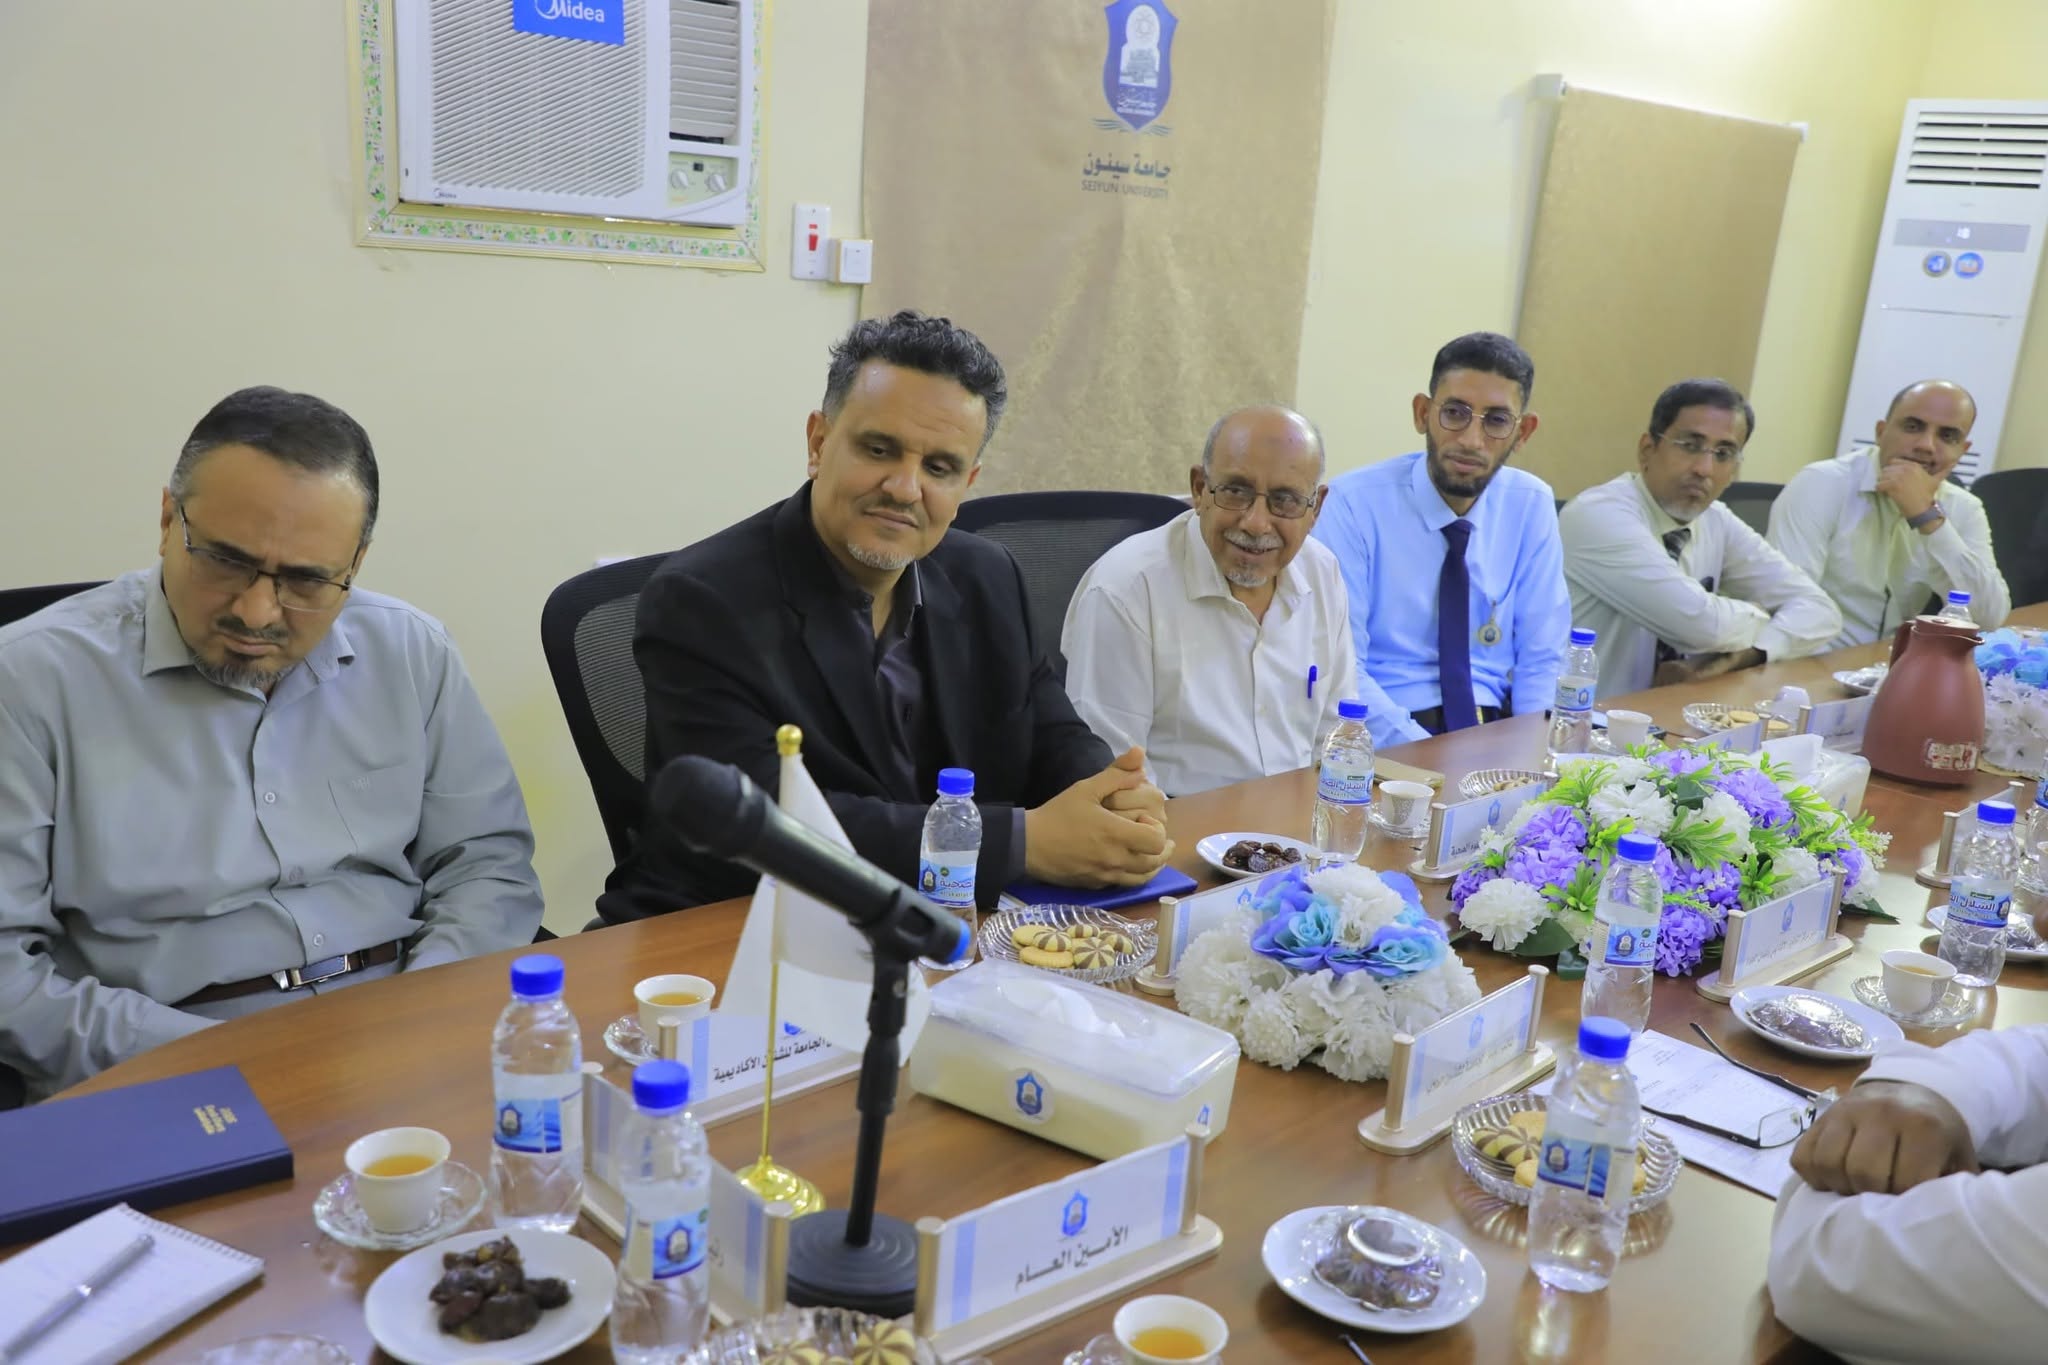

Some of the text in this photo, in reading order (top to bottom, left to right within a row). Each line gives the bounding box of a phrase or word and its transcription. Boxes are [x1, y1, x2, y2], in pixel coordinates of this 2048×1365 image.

[535, 0, 605, 23] Midea
[1133, 154, 1171, 184] جامعة
[794, 1036, 825, 1055] الجامعة
